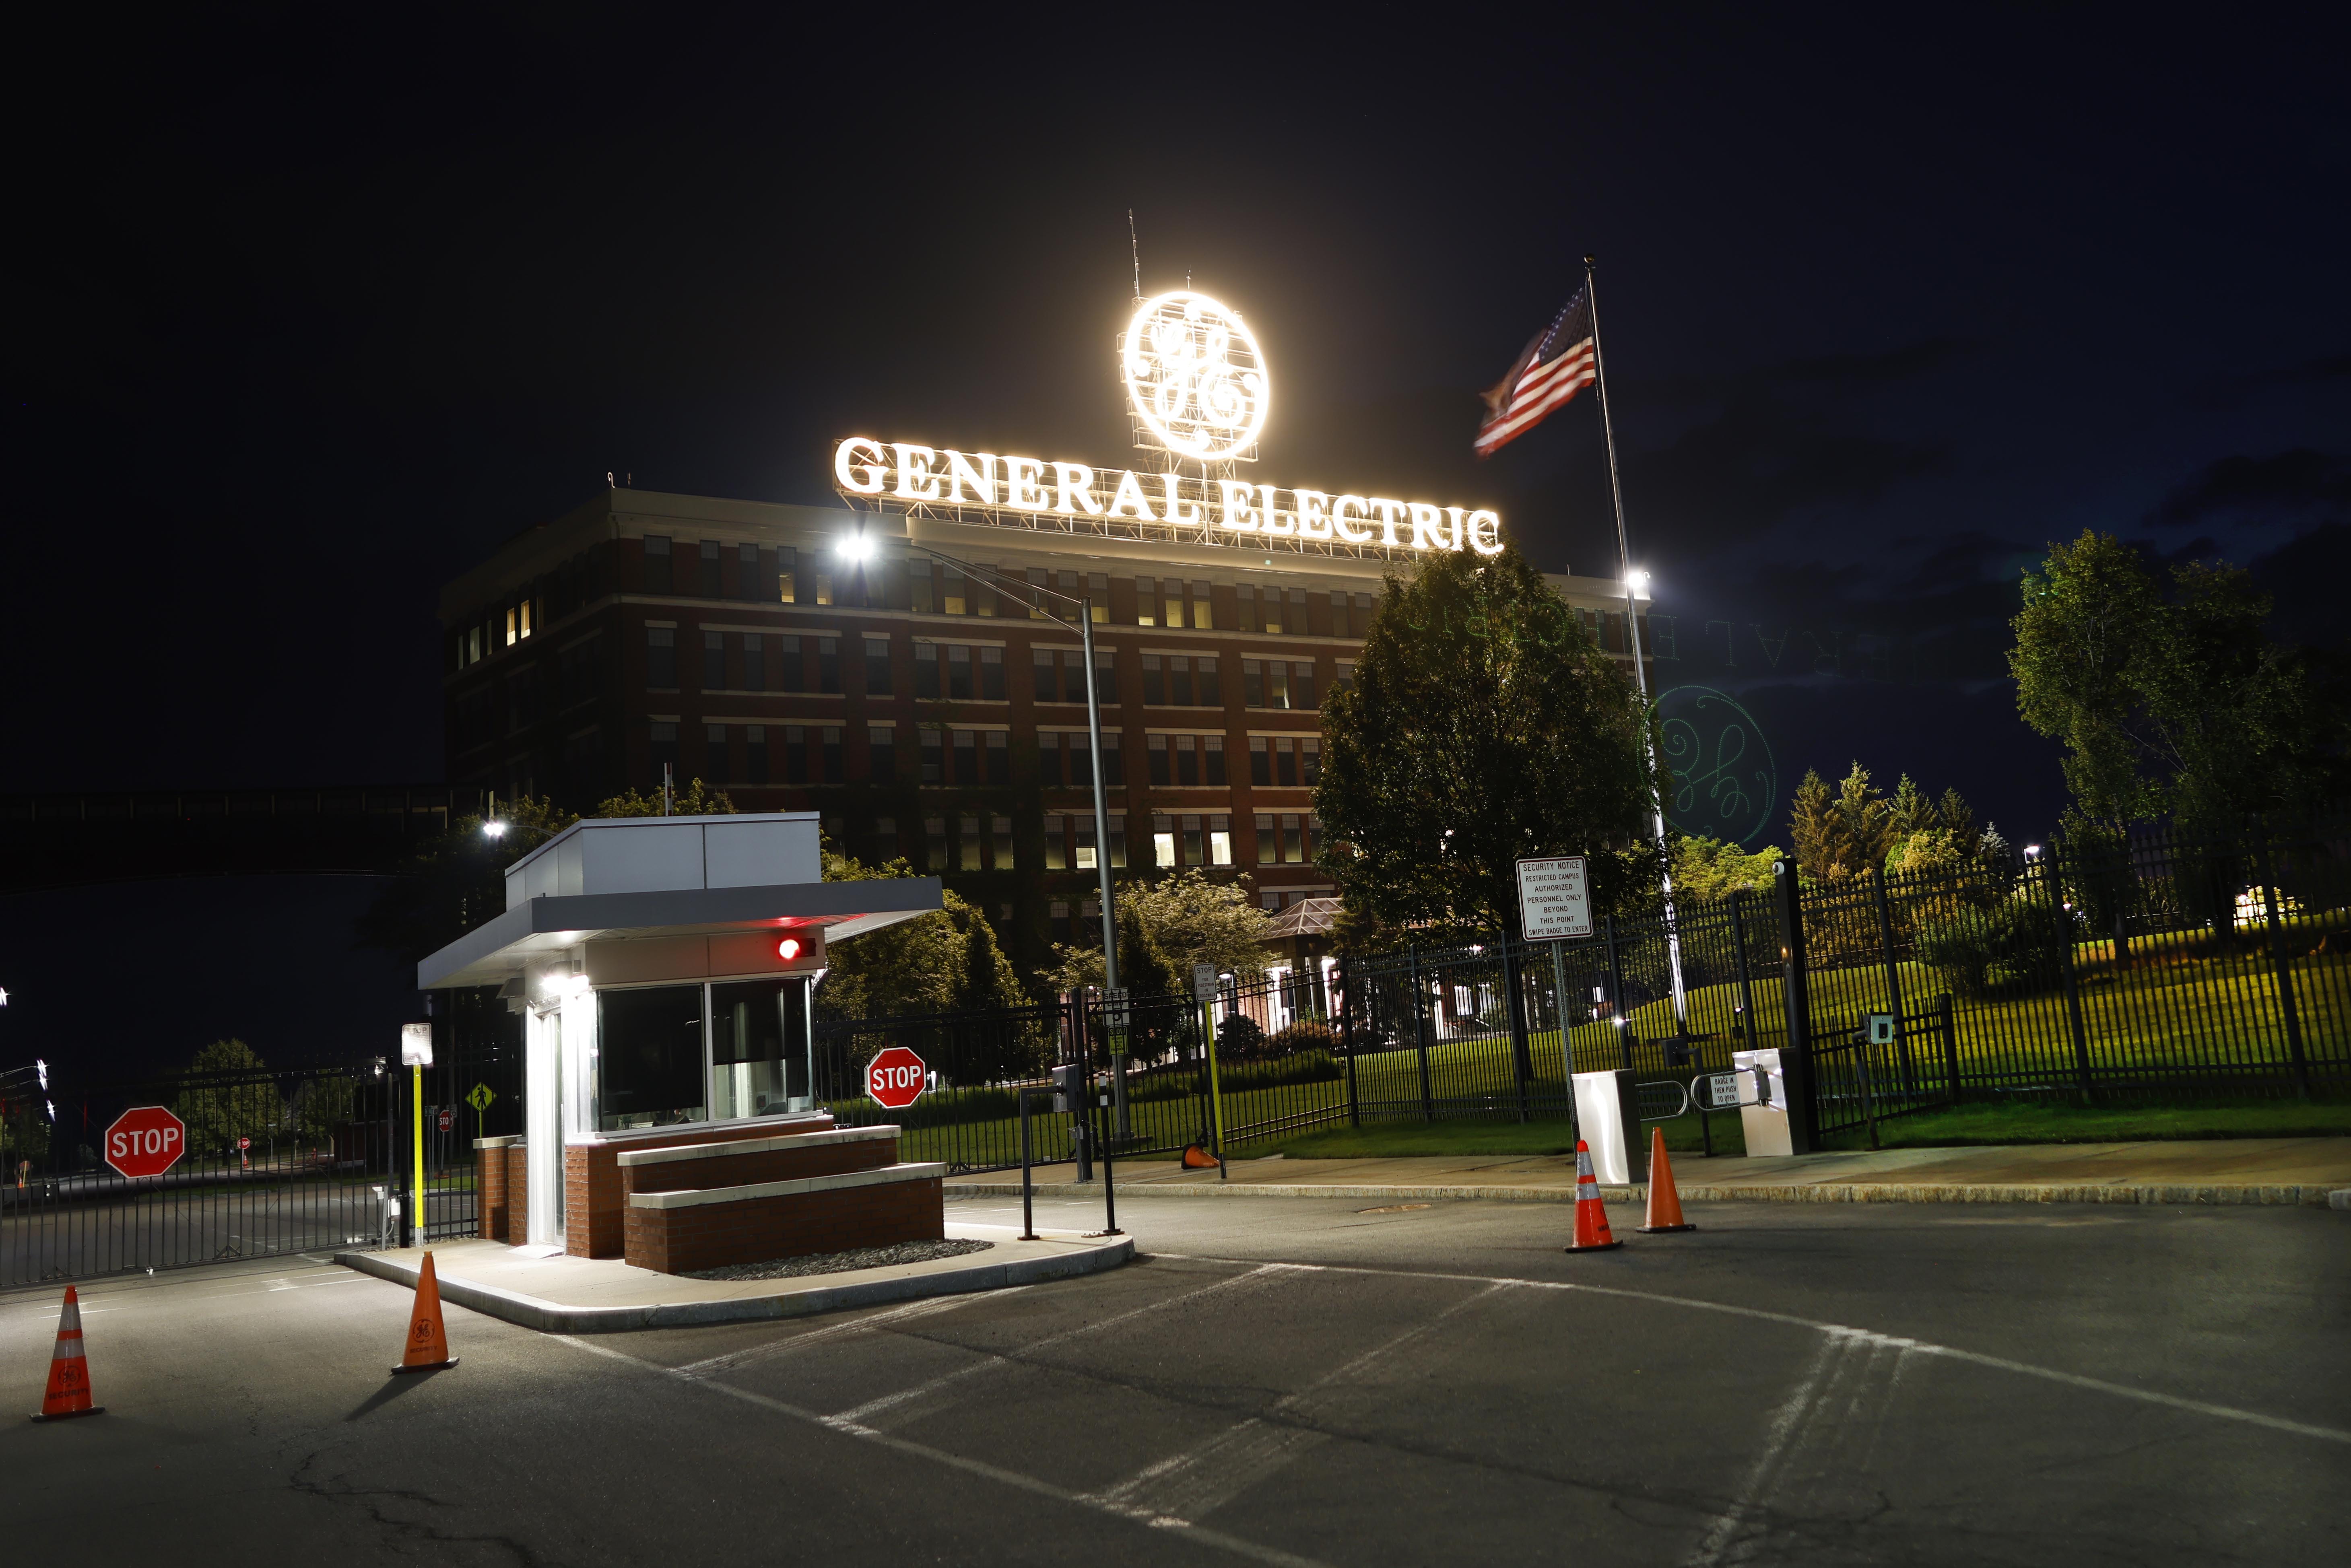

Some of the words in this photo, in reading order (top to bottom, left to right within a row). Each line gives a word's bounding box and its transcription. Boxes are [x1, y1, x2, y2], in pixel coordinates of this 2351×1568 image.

[834, 436, 1200, 525] GENERAL
[1217, 480, 1505, 555] ELECTRIC
[1523, 862, 1554, 872] SECURITY
[1558, 861, 1579, 870] NOTICE
[1535, 884, 1573, 892] AUTHORIZED
[1527, 895, 1563, 903] PERSONNEL
[872, 1065, 921, 1091] STOP
[439, 1117, 452, 1125] STO
[111, 1127, 179, 1157] STOP
[49, 1388, 89, 1400] SECURITY
